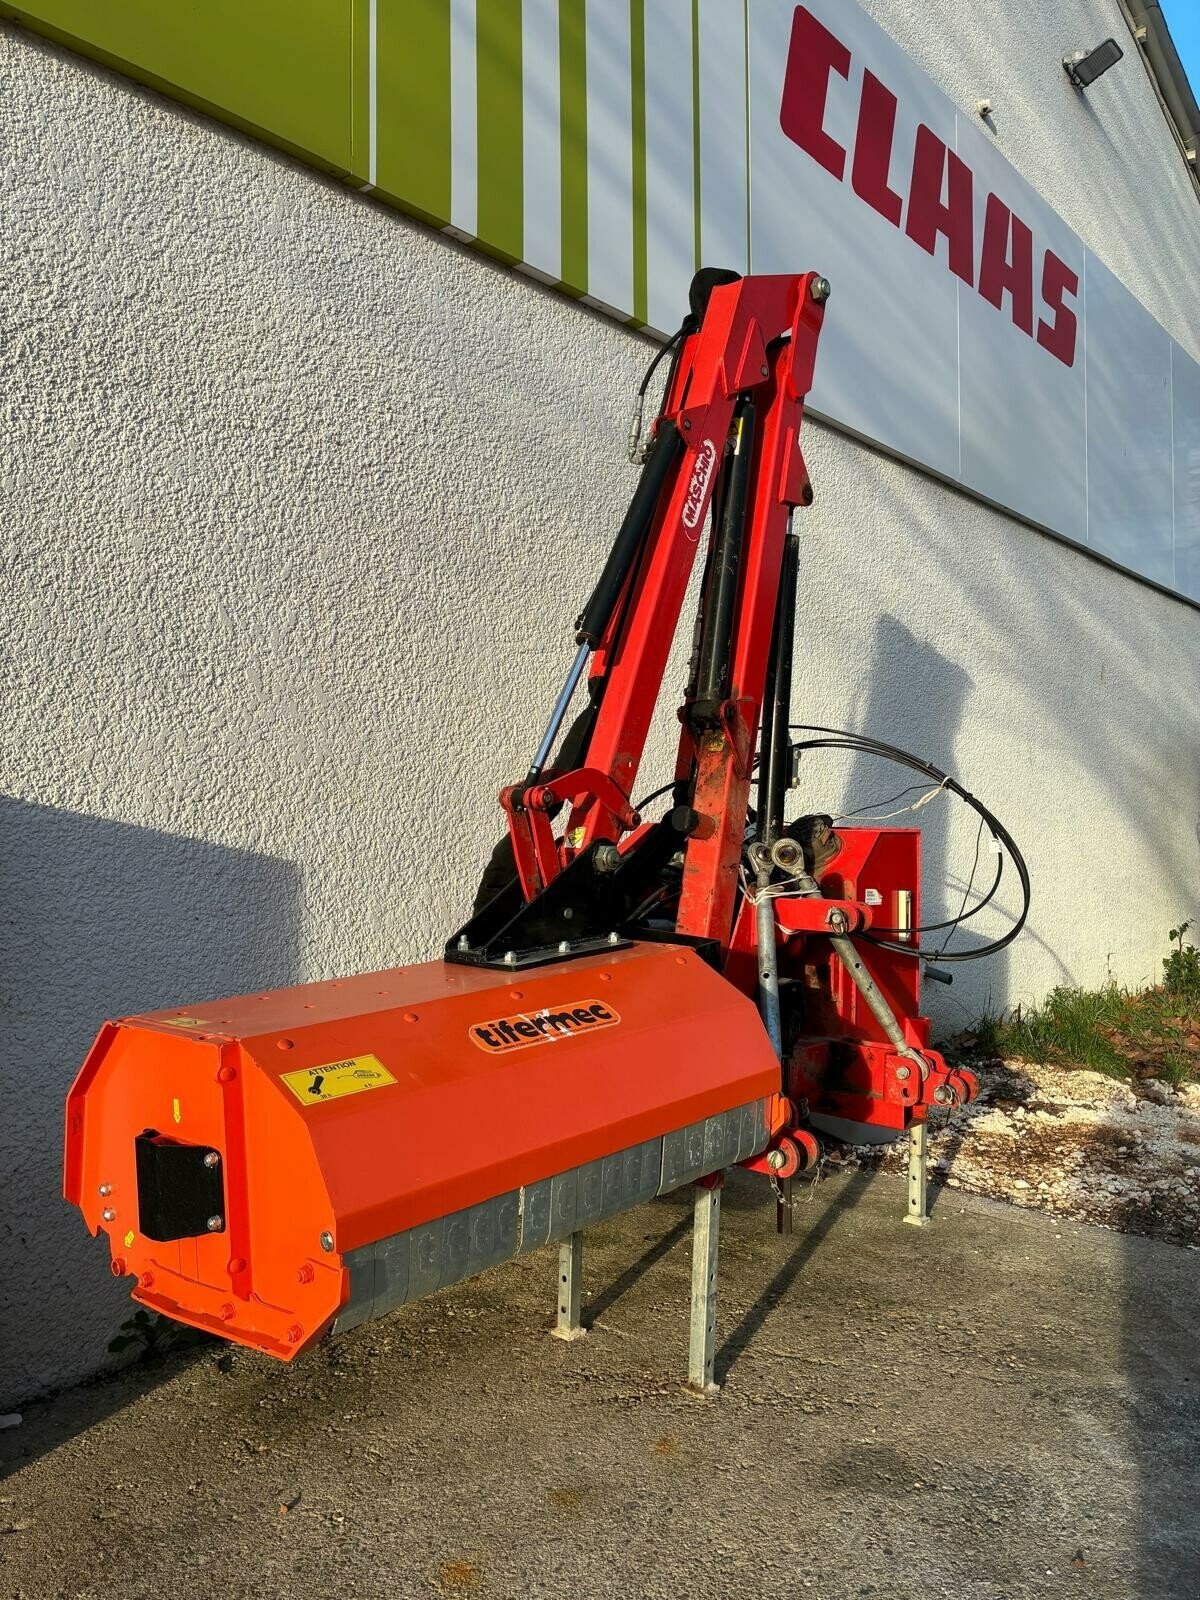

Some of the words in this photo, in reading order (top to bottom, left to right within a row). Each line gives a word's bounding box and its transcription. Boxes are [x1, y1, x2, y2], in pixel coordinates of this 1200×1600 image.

[780, 4, 1079, 368] CLAAS
[684, 443, 713, 525] MASCHIO
[474, 1004, 613, 1048] tifermec
[308, 1060, 357, 1077] ATTENTION
